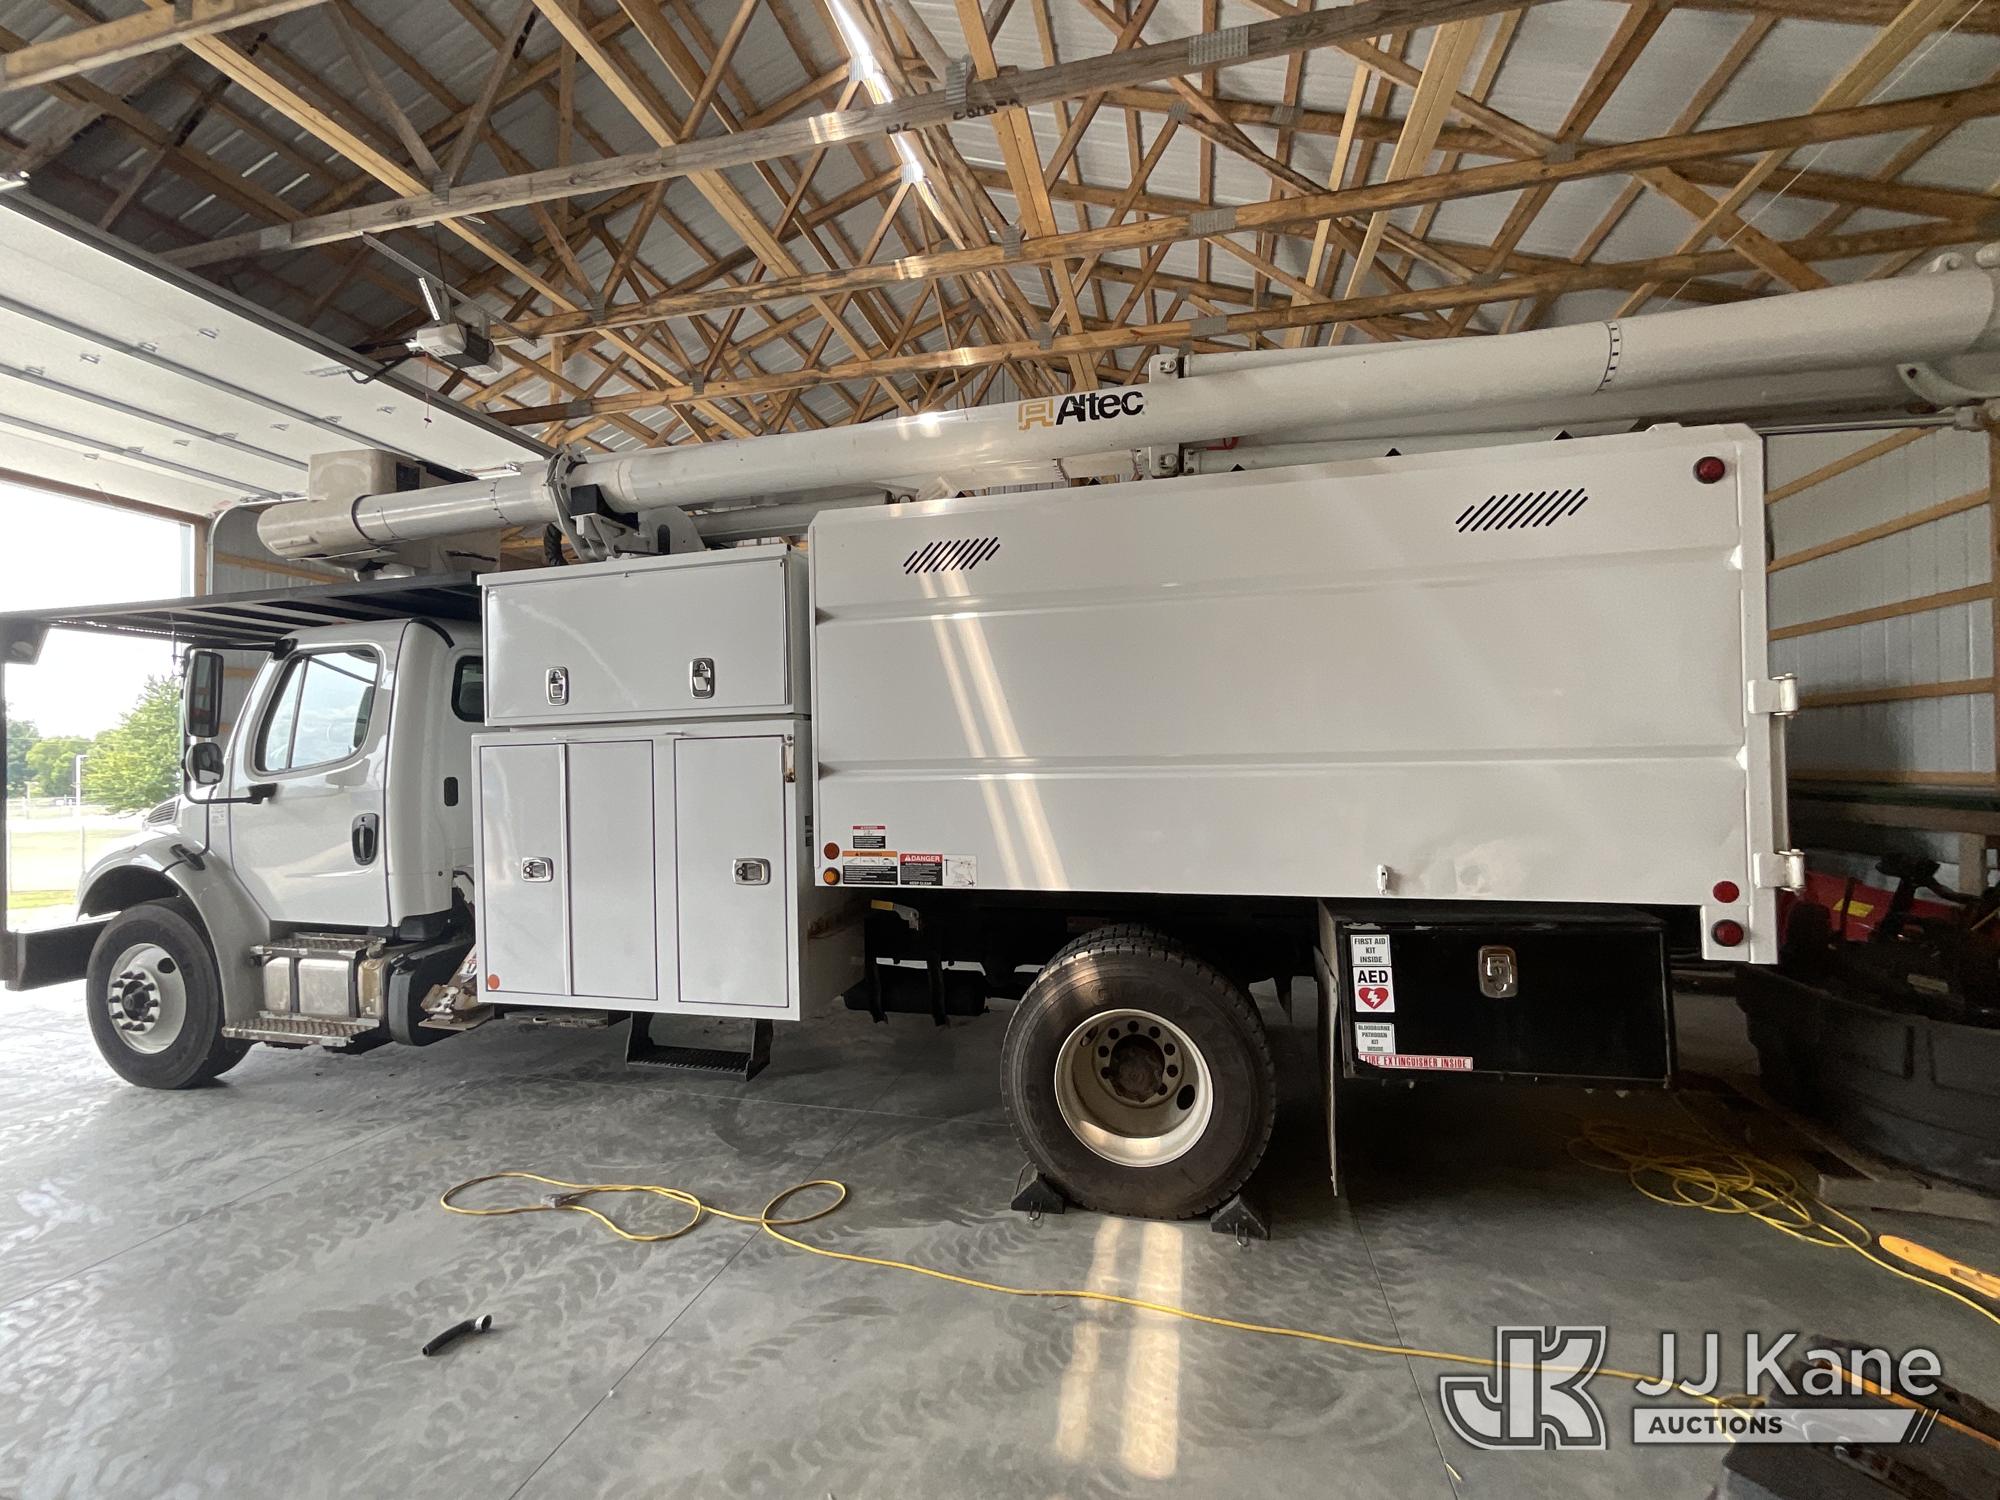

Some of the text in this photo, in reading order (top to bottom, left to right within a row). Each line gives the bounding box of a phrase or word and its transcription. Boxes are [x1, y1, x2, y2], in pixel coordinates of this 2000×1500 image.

[1056, 390, 1144, 425] Altec
[1358, 970, 1388, 983] AED
[1384, 1056, 1437, 1067] EXTINGUISHER
[1441, 1059, 1466, 1068] INSIDE
